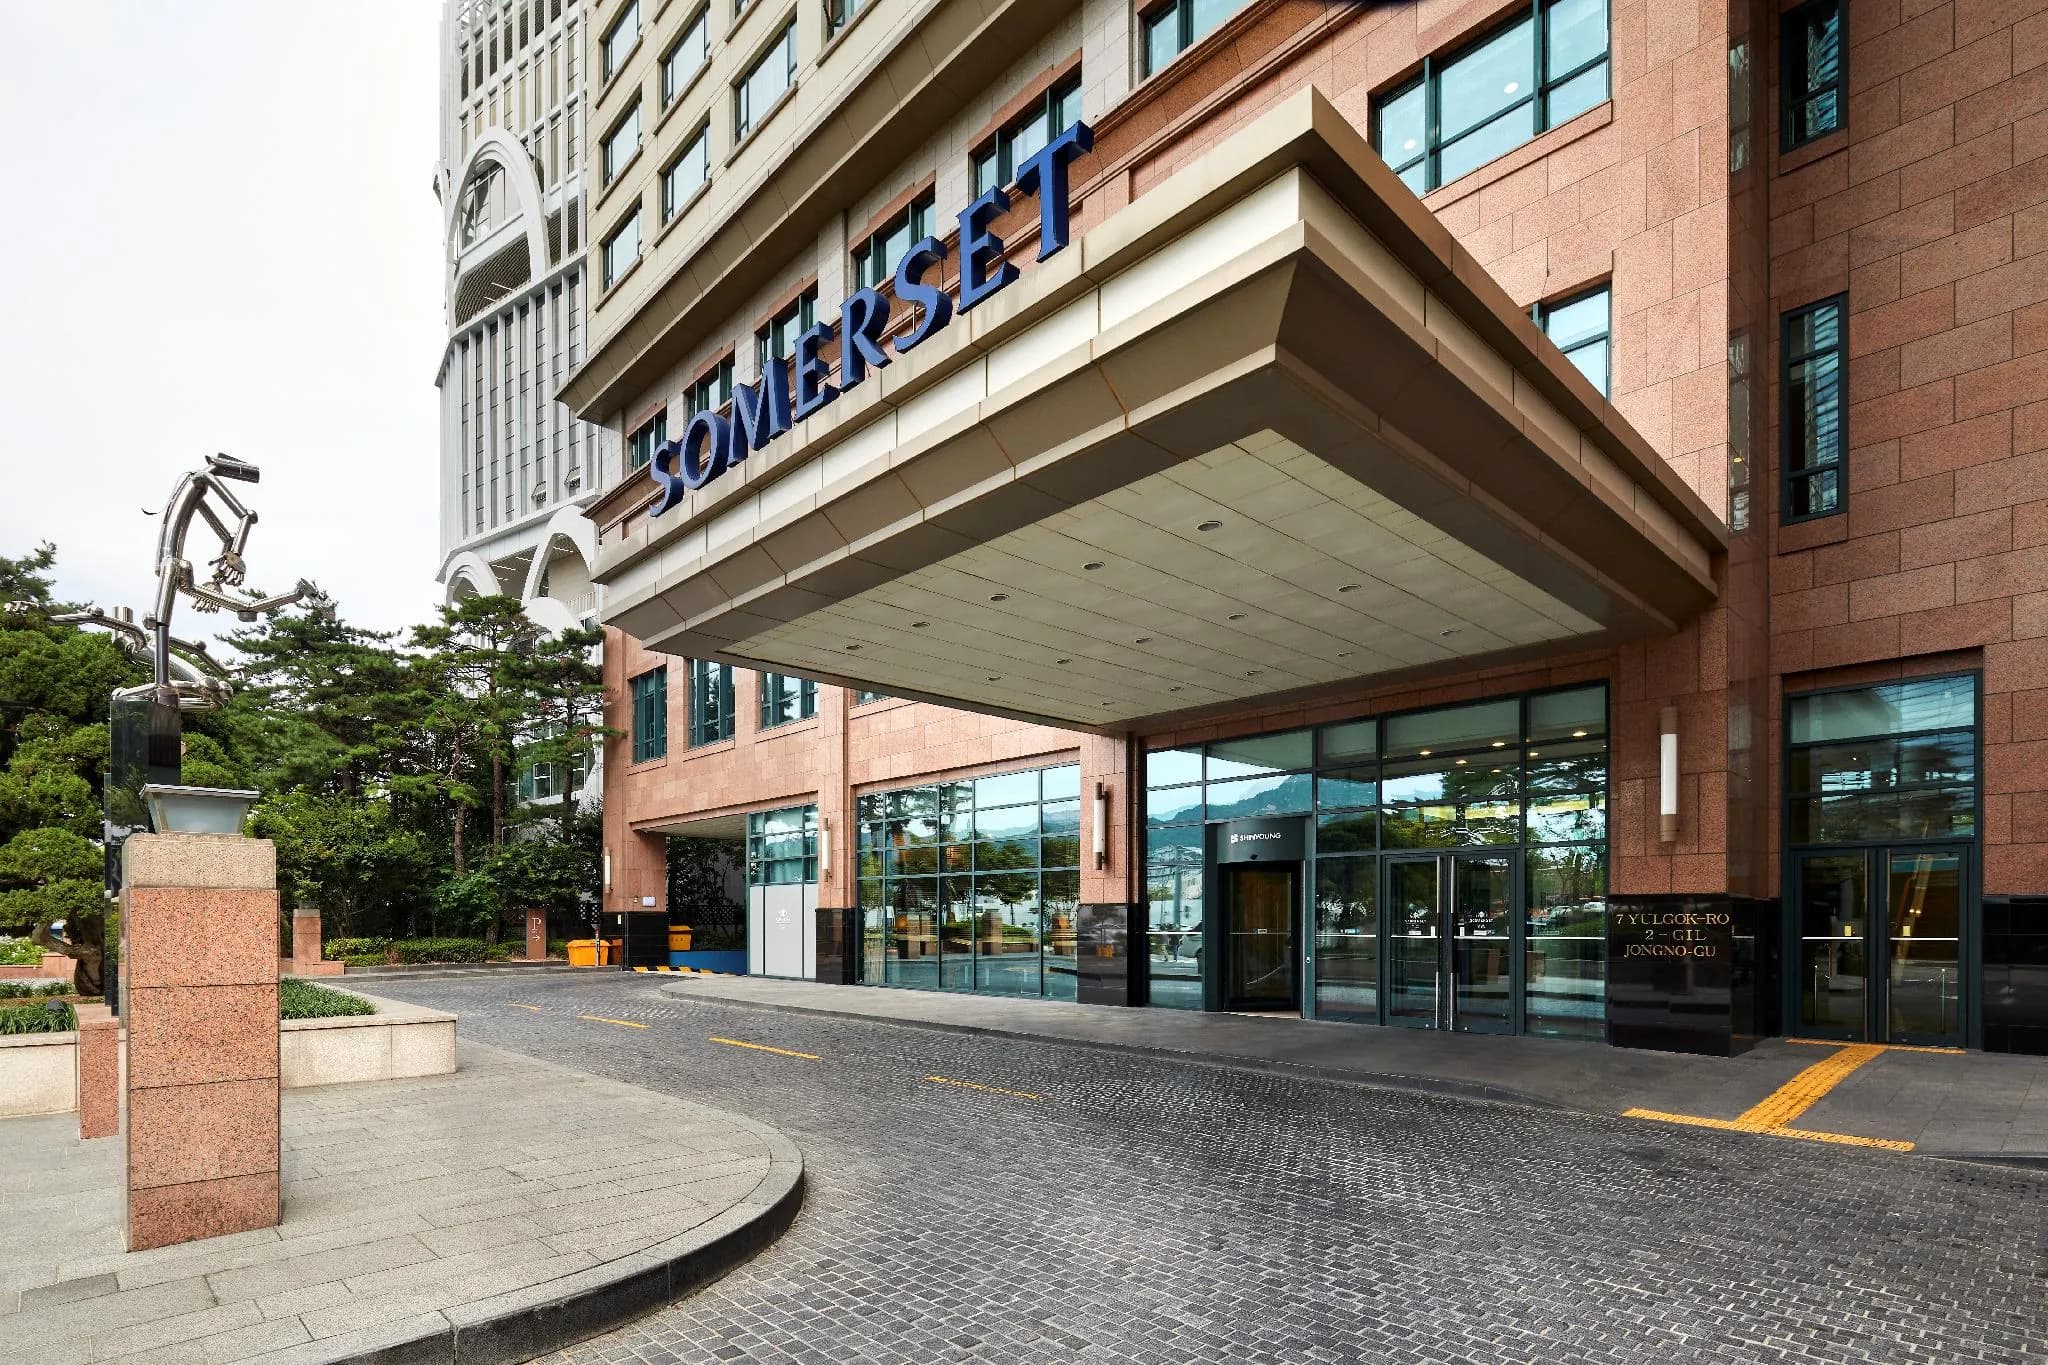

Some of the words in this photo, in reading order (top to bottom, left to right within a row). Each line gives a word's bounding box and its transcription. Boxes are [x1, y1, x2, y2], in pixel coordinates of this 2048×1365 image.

[649, 120, 1094, 517] SOMERSET
[531, 917, 542, 931] P
[1616, 914, 1624, 925] 7
[1626, 913, 1730, 925] YULGOK-RO
[1623, 944, 1716, 958] JONGNO-GU
